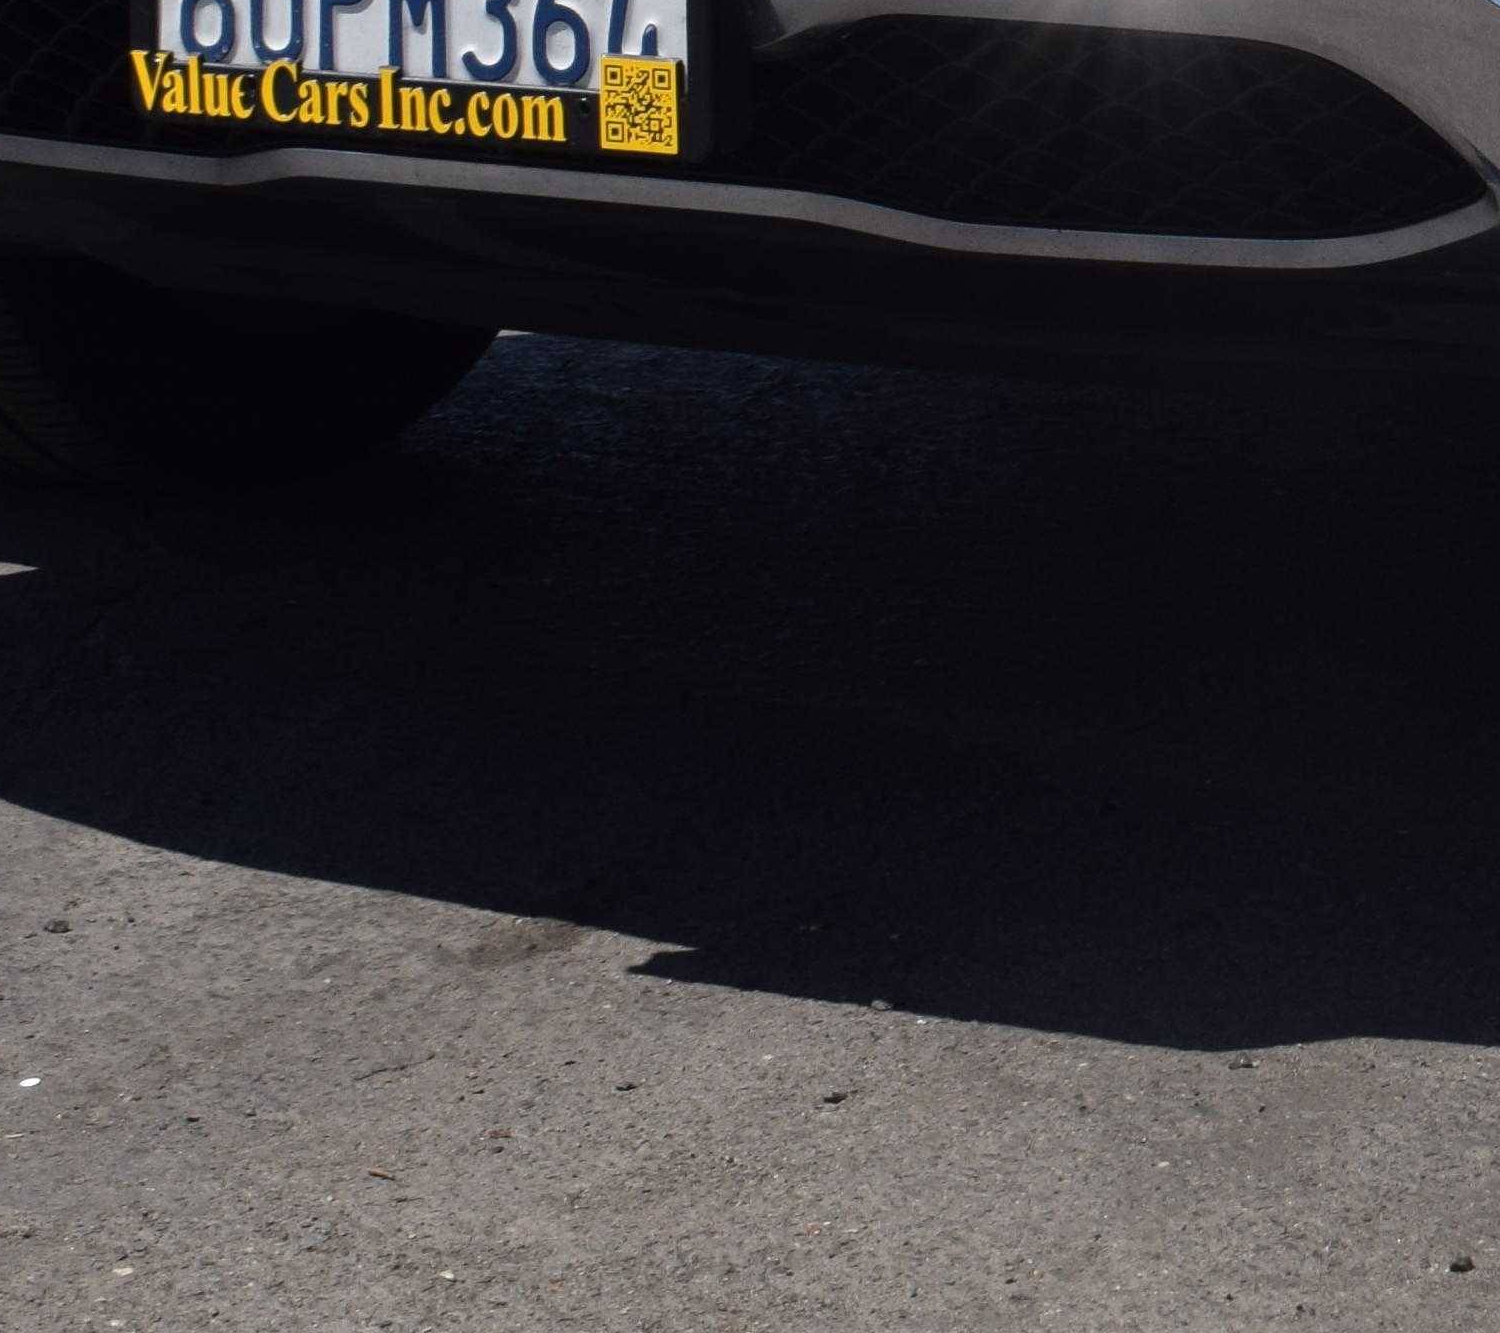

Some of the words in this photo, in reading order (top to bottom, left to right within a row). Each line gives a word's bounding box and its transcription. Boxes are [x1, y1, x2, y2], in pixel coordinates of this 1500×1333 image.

[130, 49, 256, 119] Value
[260, 58, 370, 129] Cars
[377, 65, 568, 143] Inc.com
